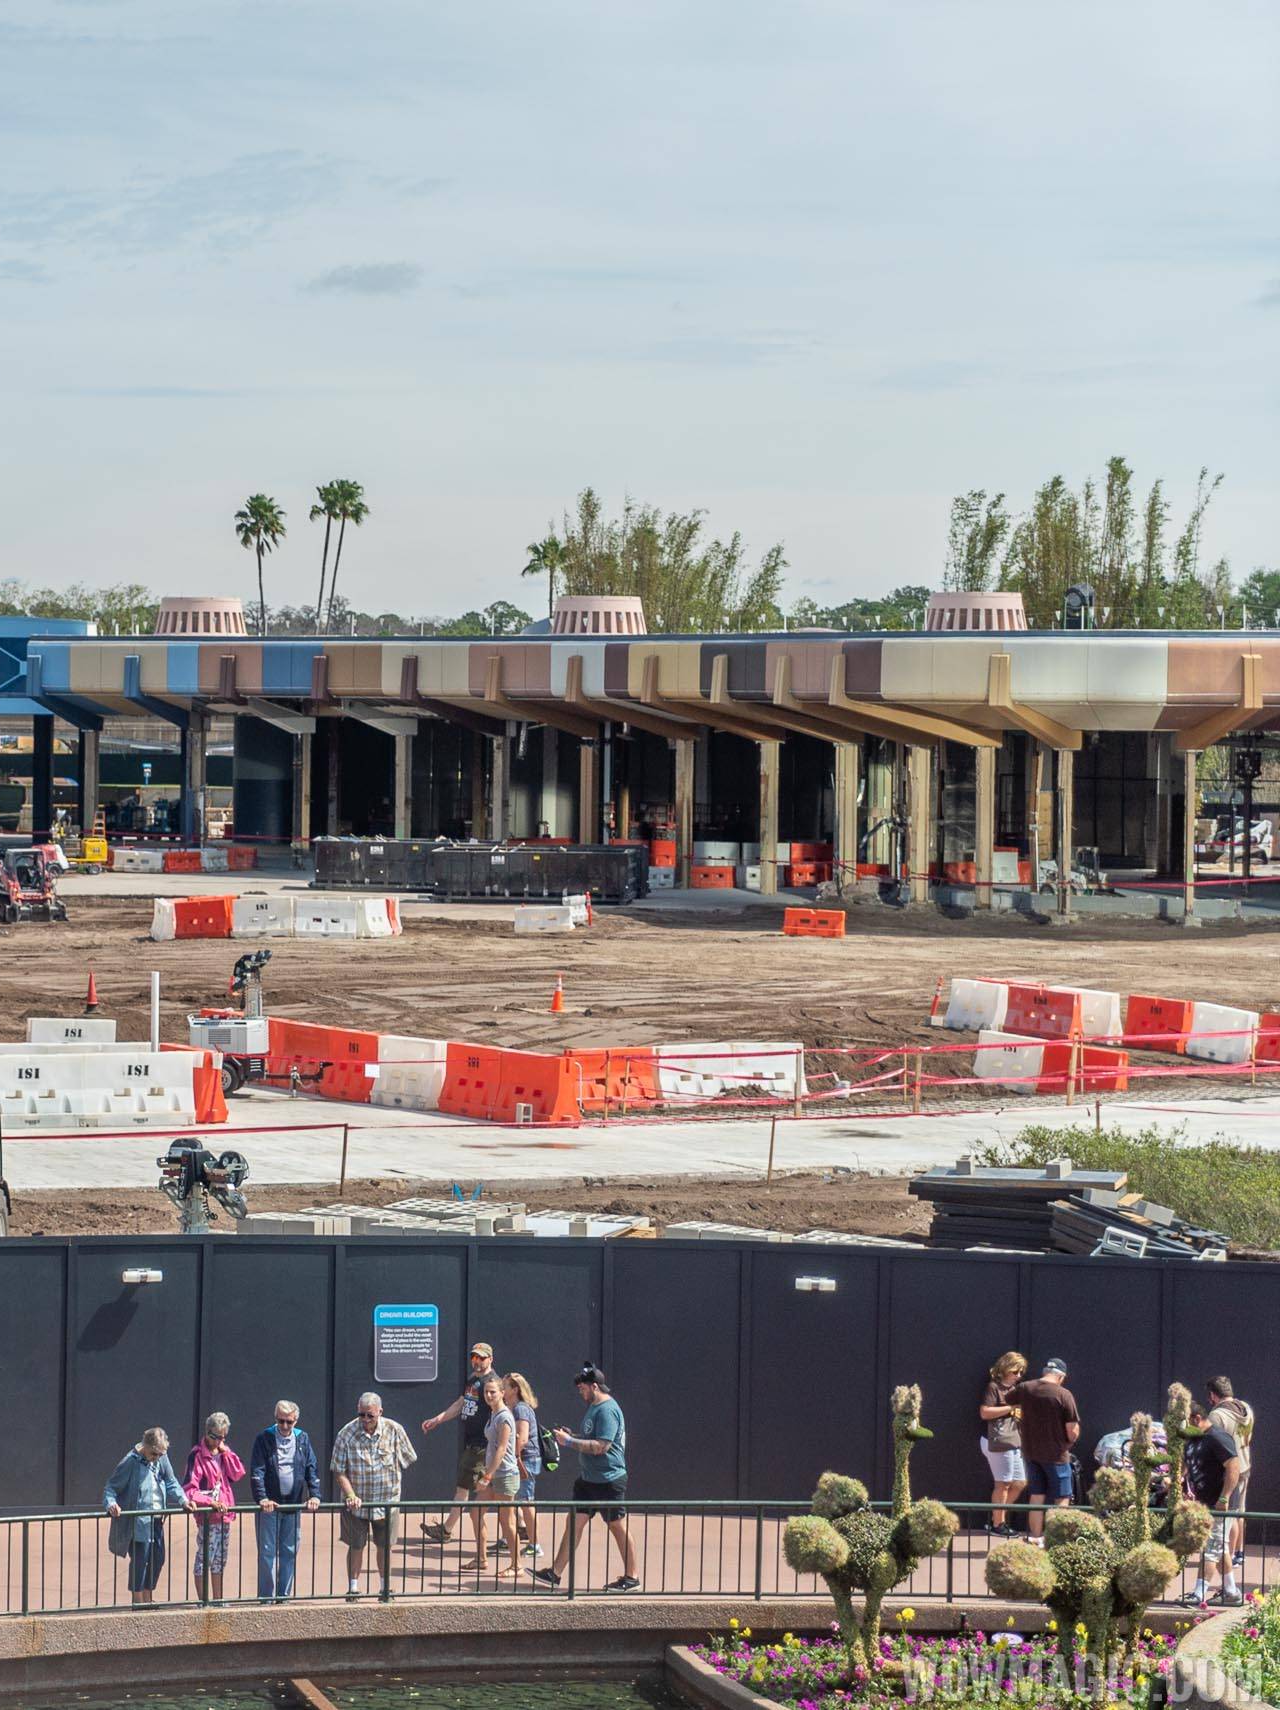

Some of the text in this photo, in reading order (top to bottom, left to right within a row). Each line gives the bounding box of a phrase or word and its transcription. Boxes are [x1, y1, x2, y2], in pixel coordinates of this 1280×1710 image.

[255, 903, 268, 911] ISI
[64, 1028, 83, 1038] ISI
[17, 1067, 41, 1080] ISI
[127, 1064, 150, 1077] ISI
